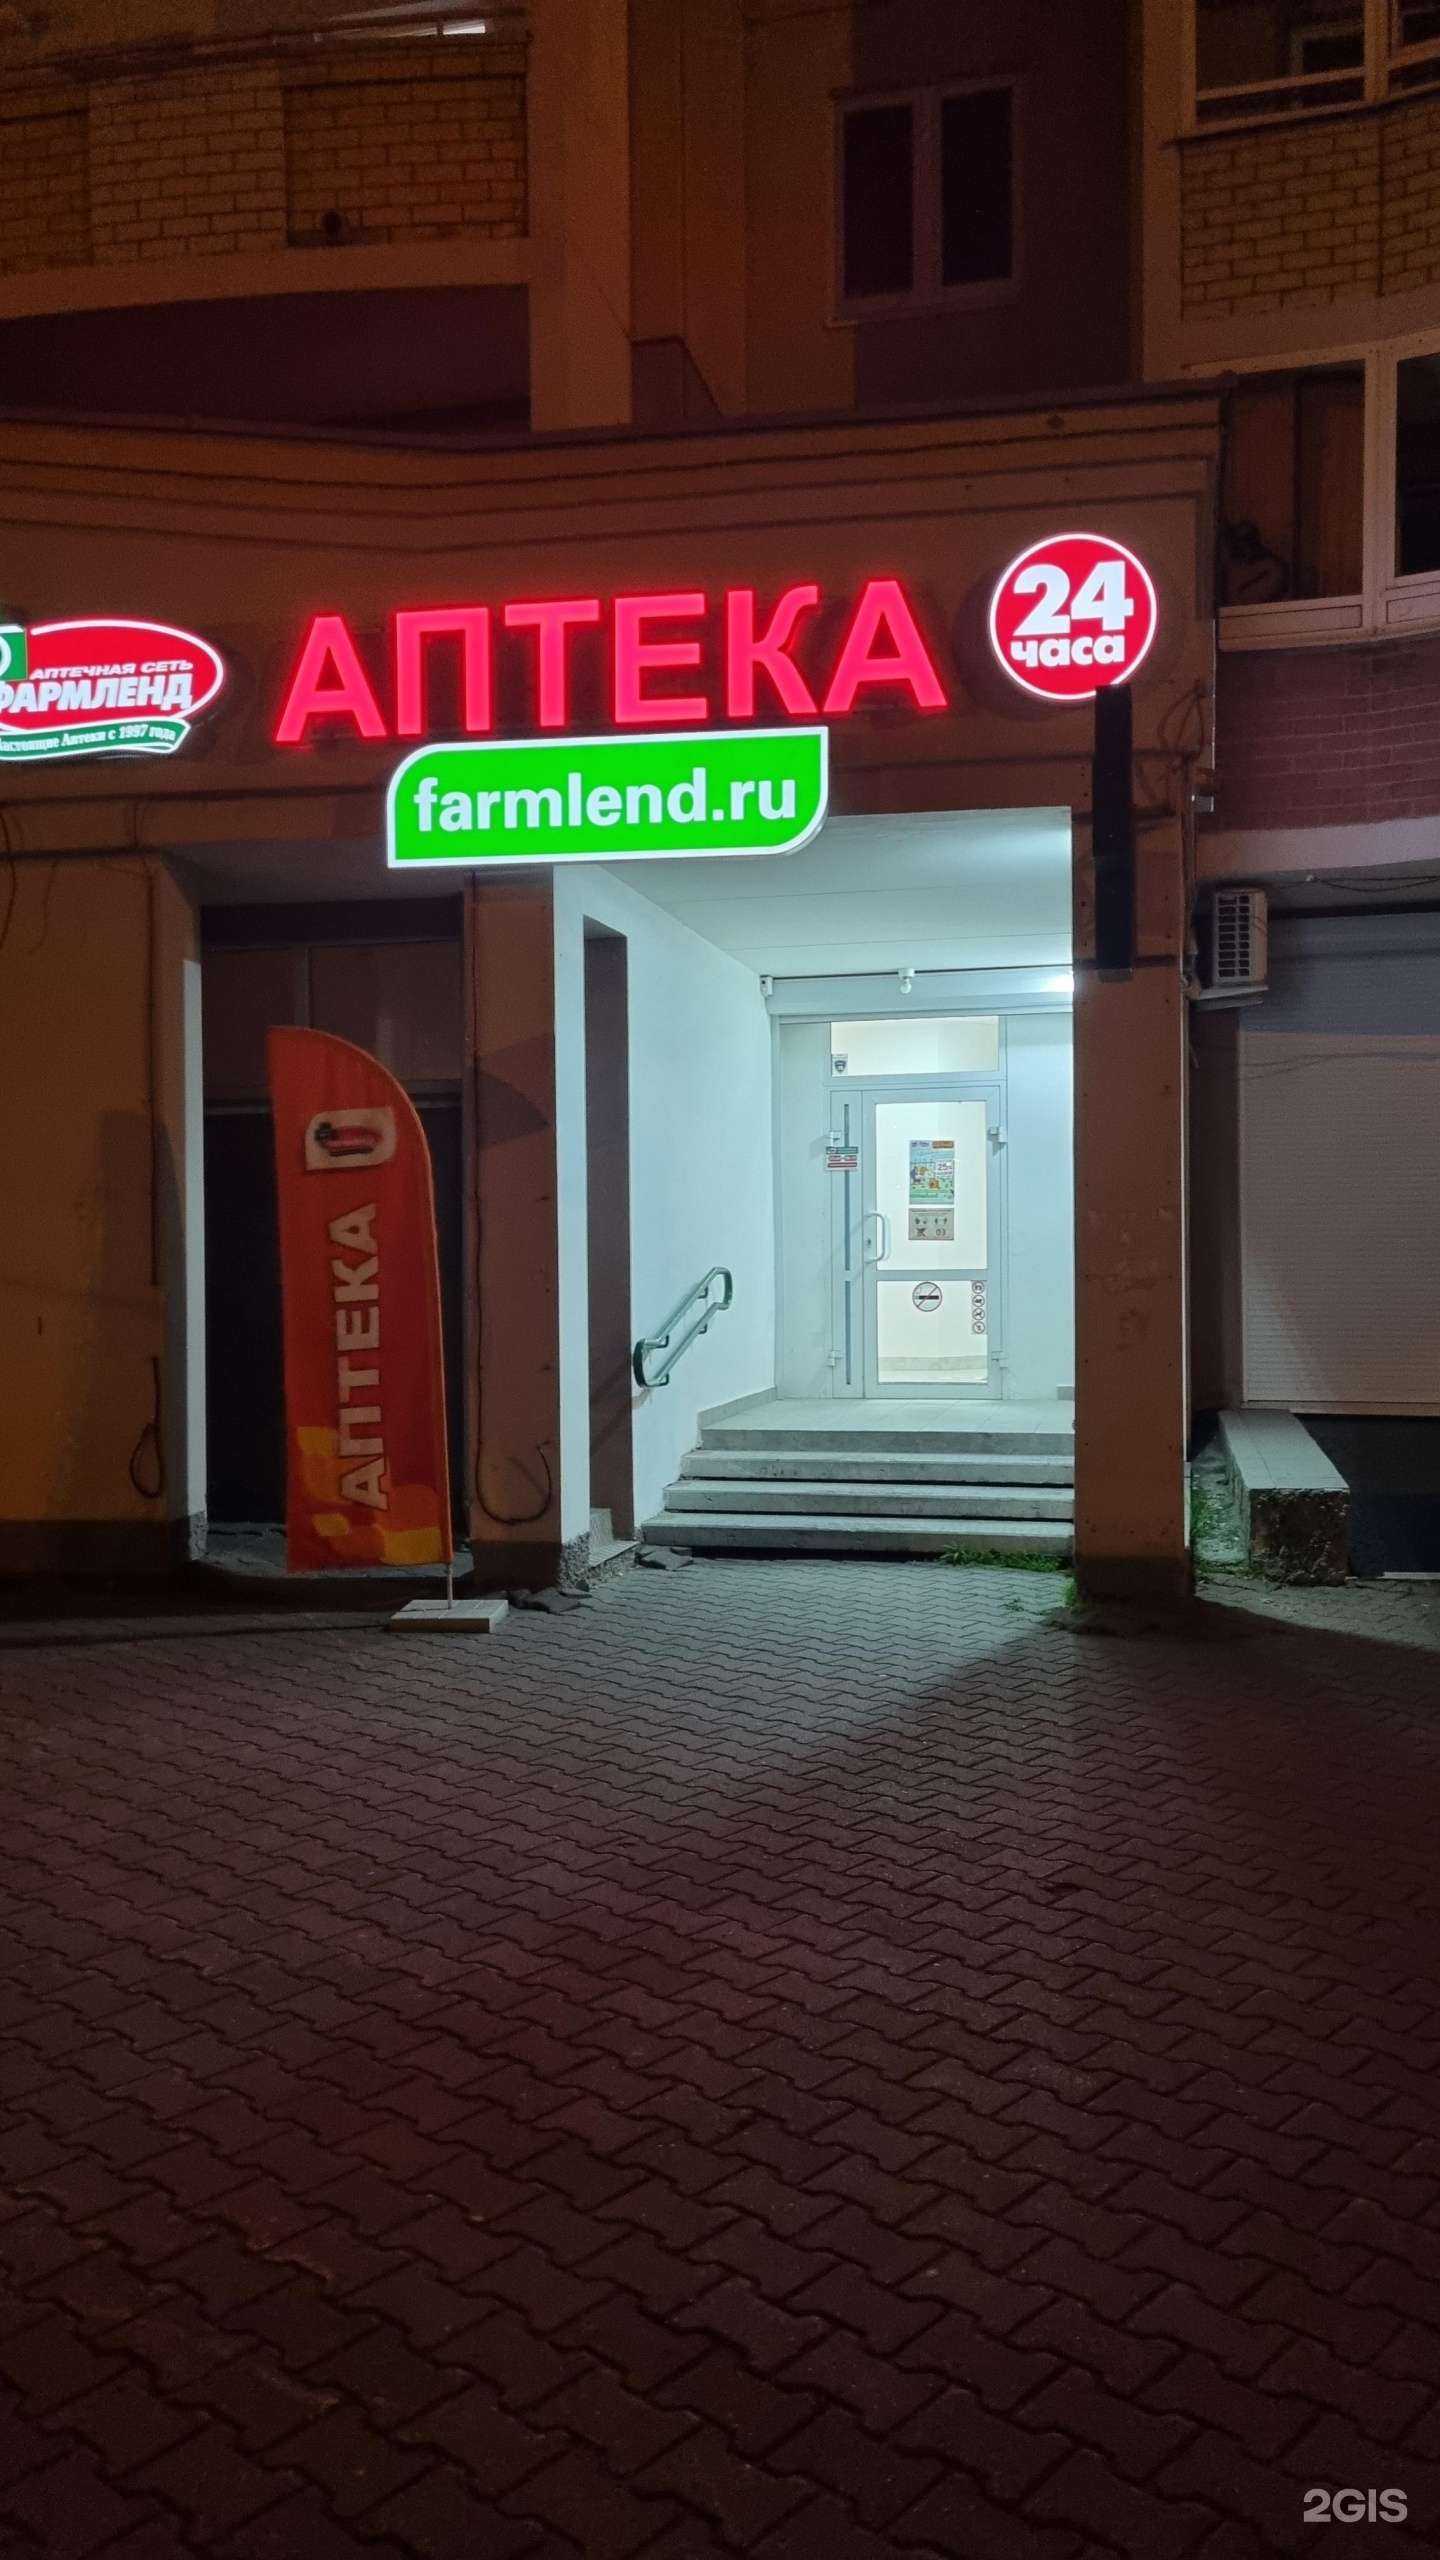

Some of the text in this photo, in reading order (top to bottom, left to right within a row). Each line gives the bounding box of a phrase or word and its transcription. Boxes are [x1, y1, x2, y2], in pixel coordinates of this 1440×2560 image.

[1013, 560, 1134, 636] 24
[29, 660, 194, 680] АПТЕЧНАЯ СЕТЬ
[275, 580, 947, 742] АПТЕКА
[1010, 635, 1126, 668] часа
[0, 724, 176, 752] астоящие Аптеки с 1997 года
[413, 767, 796, 832] farmlend.ru
[327, 1202, 391, 1512] АПТЕКА
